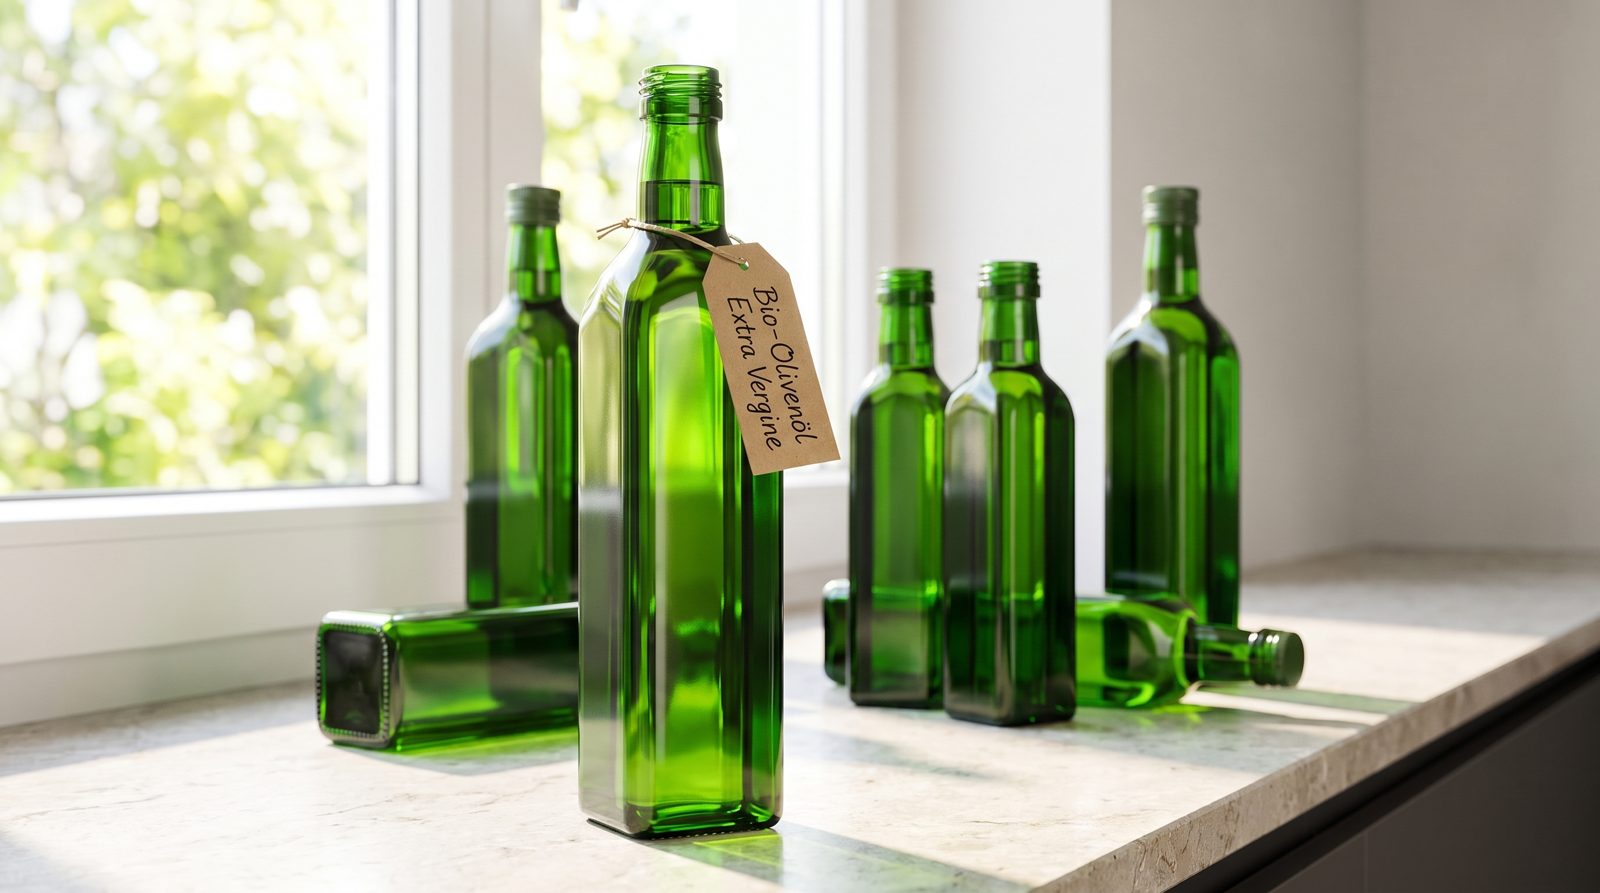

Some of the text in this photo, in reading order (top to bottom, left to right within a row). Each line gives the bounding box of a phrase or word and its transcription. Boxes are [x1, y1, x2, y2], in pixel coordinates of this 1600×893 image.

[727, 297, 782, 451] Extra Vergine
[753, 286, 818, 444] Bio-Olivenöl
